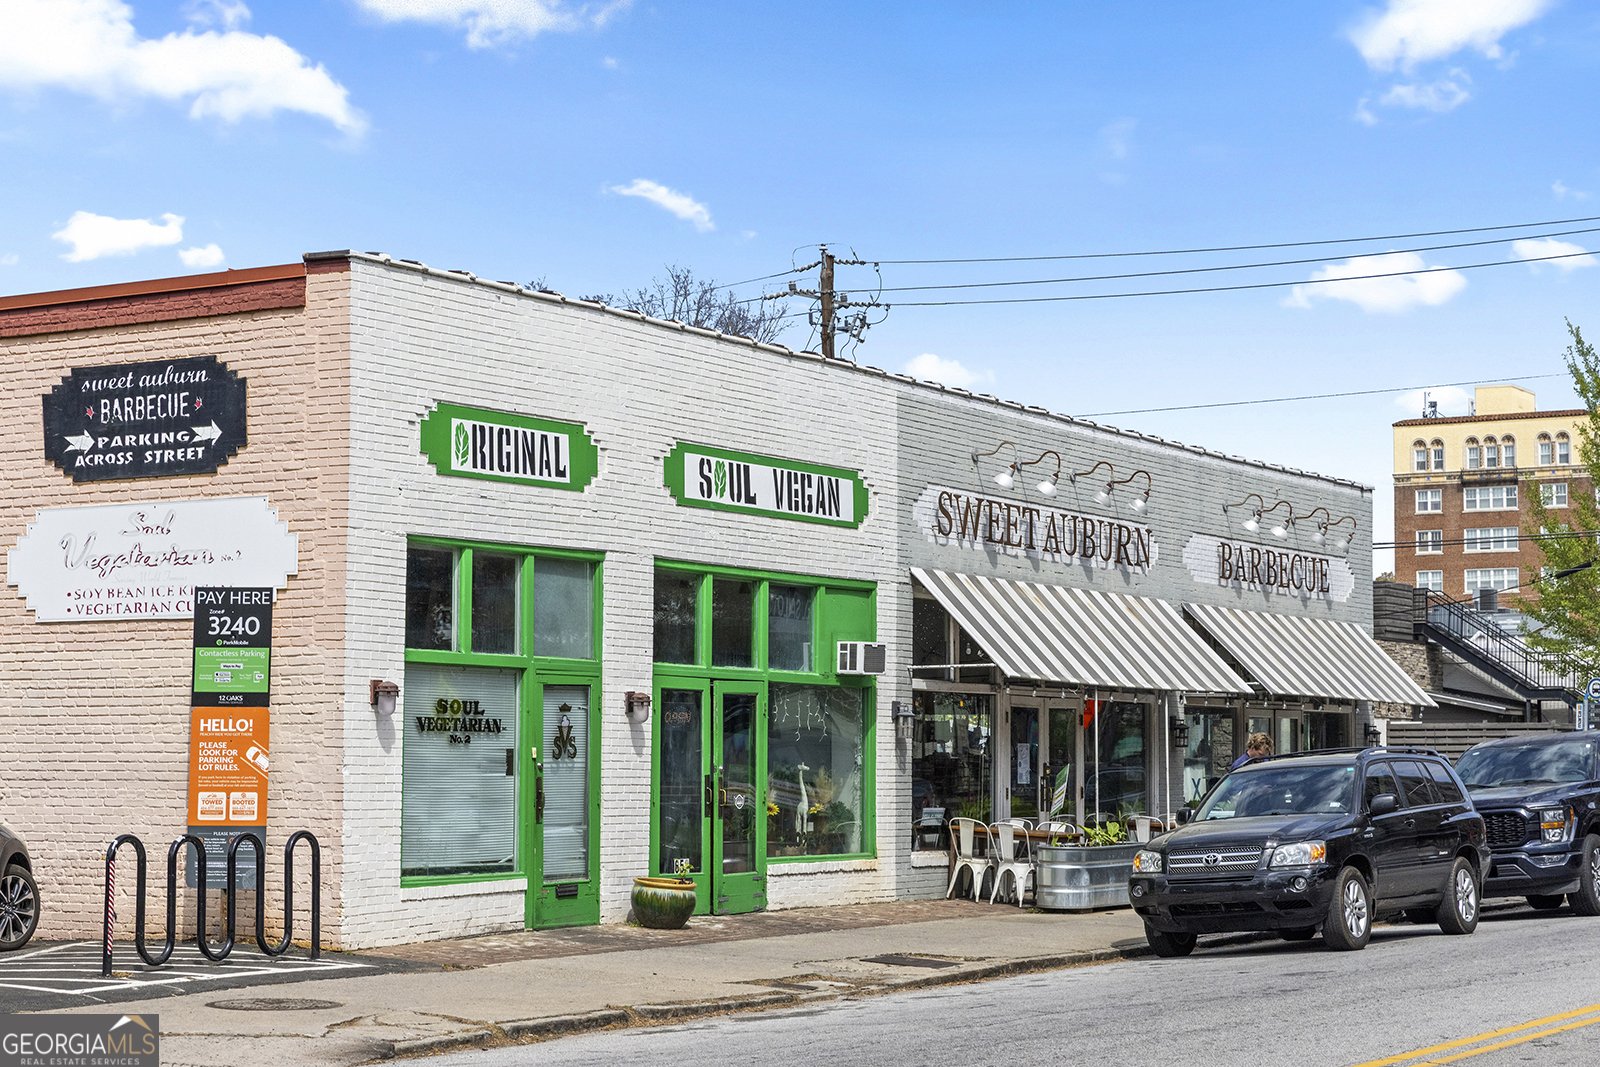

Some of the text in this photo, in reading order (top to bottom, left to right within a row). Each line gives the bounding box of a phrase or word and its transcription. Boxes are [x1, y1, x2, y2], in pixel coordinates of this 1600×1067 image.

[82, 365, 209, 392] sweet auburn
[100, 391, 190, 424] BARBECUE
[97, 431, 190, 448] PARKING
[75, 447, 205, 468] ACROSS STREET
[772, 468, 841, 518] VEGAN
[937, 491, 1153, 569] SWEET AUBURN
[1218, 541, 1331, 593] BARBECUE
[74, 588, 103, 600] SOY
[107, 586, 146, 599] BEAN
[151, 586, 175, 598] ICE
[197, 591, 226, 605] PAY
[230, 591, 271, 605] HERE
[75, 601, 171, 615] VEGETARIAN
[208, 616, 261, 635] 3240
[199, 649, 266, 659] Contactless Parking
[434, 698, 485, 716] SOUL
[200, 718, 254, 732] HELLO!
[415, 716, 502, 734] VEGETARIAN
[199, 741, 227, 749] PLEASE
[674, 859, 689, 874] 65
